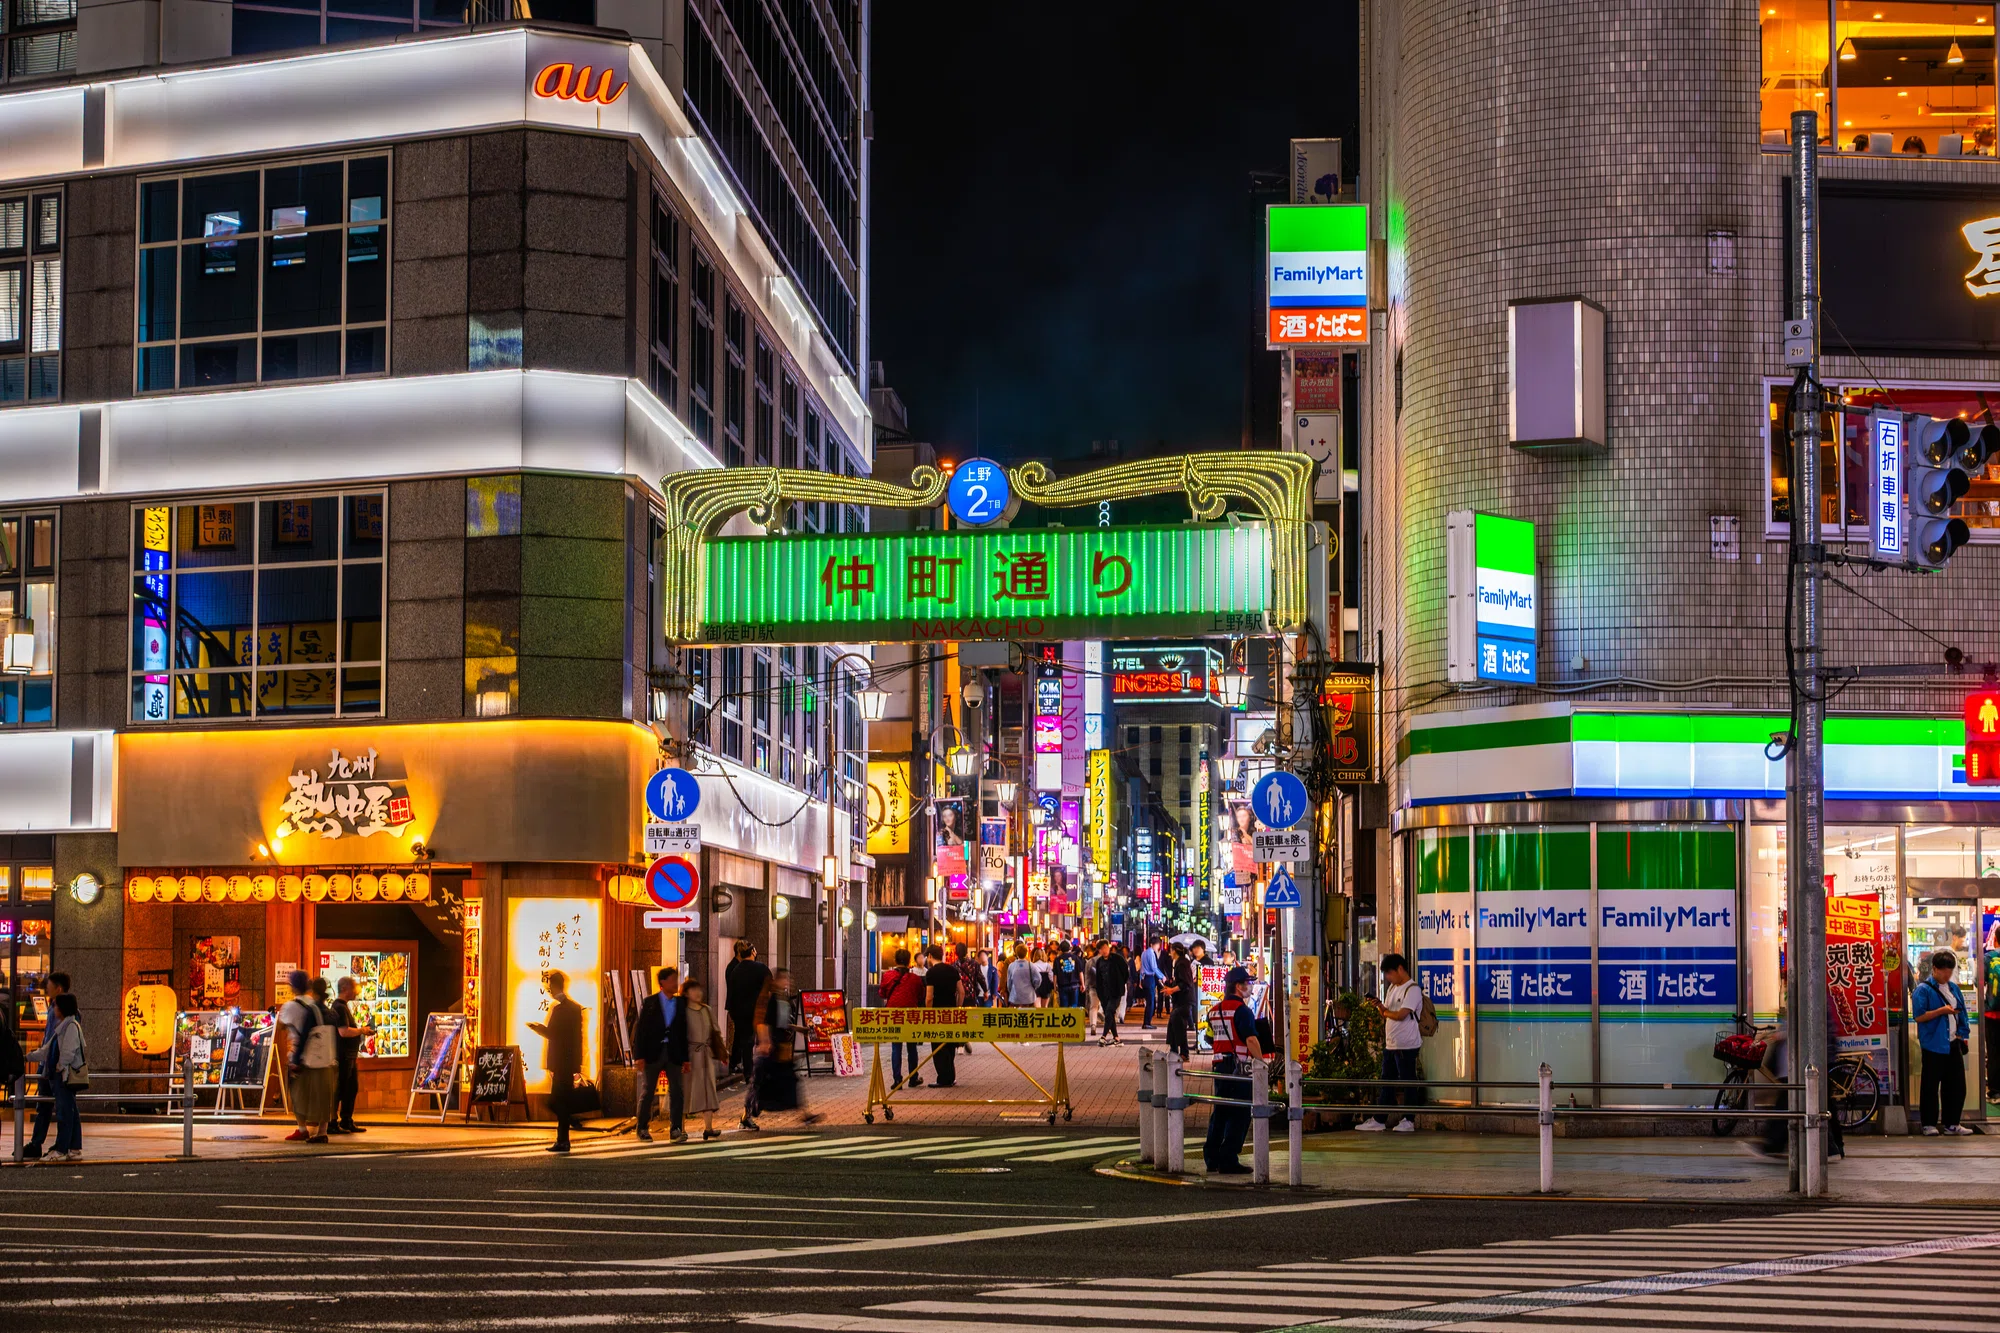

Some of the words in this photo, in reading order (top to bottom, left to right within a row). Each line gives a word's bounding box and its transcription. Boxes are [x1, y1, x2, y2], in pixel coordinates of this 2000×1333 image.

[533, 62, 627, 104] au
[1273, 266, 1363, 284] FamilyMart
[1279, 313, 1362, 338] 酒・たばこ
[1300, 379, 1334, 387] 飲み放題
[963, 468, 991, 483] 上野
[1881, 426, 1896, 547] 右折車専用
[821, 550, 1132, 607] 仲町通り
[1478, 586, 1533, 611] FamilyMart
[912, 618, 1044, 639] NAKACHO
[1207, 613, 1263, 632] 上野駅
[705, 624, 775, 642] 御徒町駅
[1483, 643, 1498, 674] 酒
[1502, 648, 1530, 675] たばこ
[1334, 676, 1370, 685] STOUTS
[327, 747, 377, 780] 九州
[1338, 771, 1366, 780] CHIPS
[648, 827, 698, 838] 自転車は通行可
[1256, 834, 1306, 846] 自転車を除く
[1869, 865, 1889, 873] レジを
[1480, 906, 1587, 932] FamilyMart
[1602, 906, 1731, 932] FamilyMart
[556, 922, 567, 960] 餃子と
[572, 913, 581, 951] サバと
[1490, 970, 1512, 1000] 酒
[1521, 972, 1573, 997] たばこ
[1618, 970, 1647, 1000] 酒
[1658, 973, 1717, 998] たばこ
[860, 1010, 968, 1025] 歩行者専用道路
[982, 1012, 1076, 1028] 車両通行止め
[856, 1026, 901, 1034] 防犯カメラ設置
[478, 1052, 504, 1069] 喫煙
